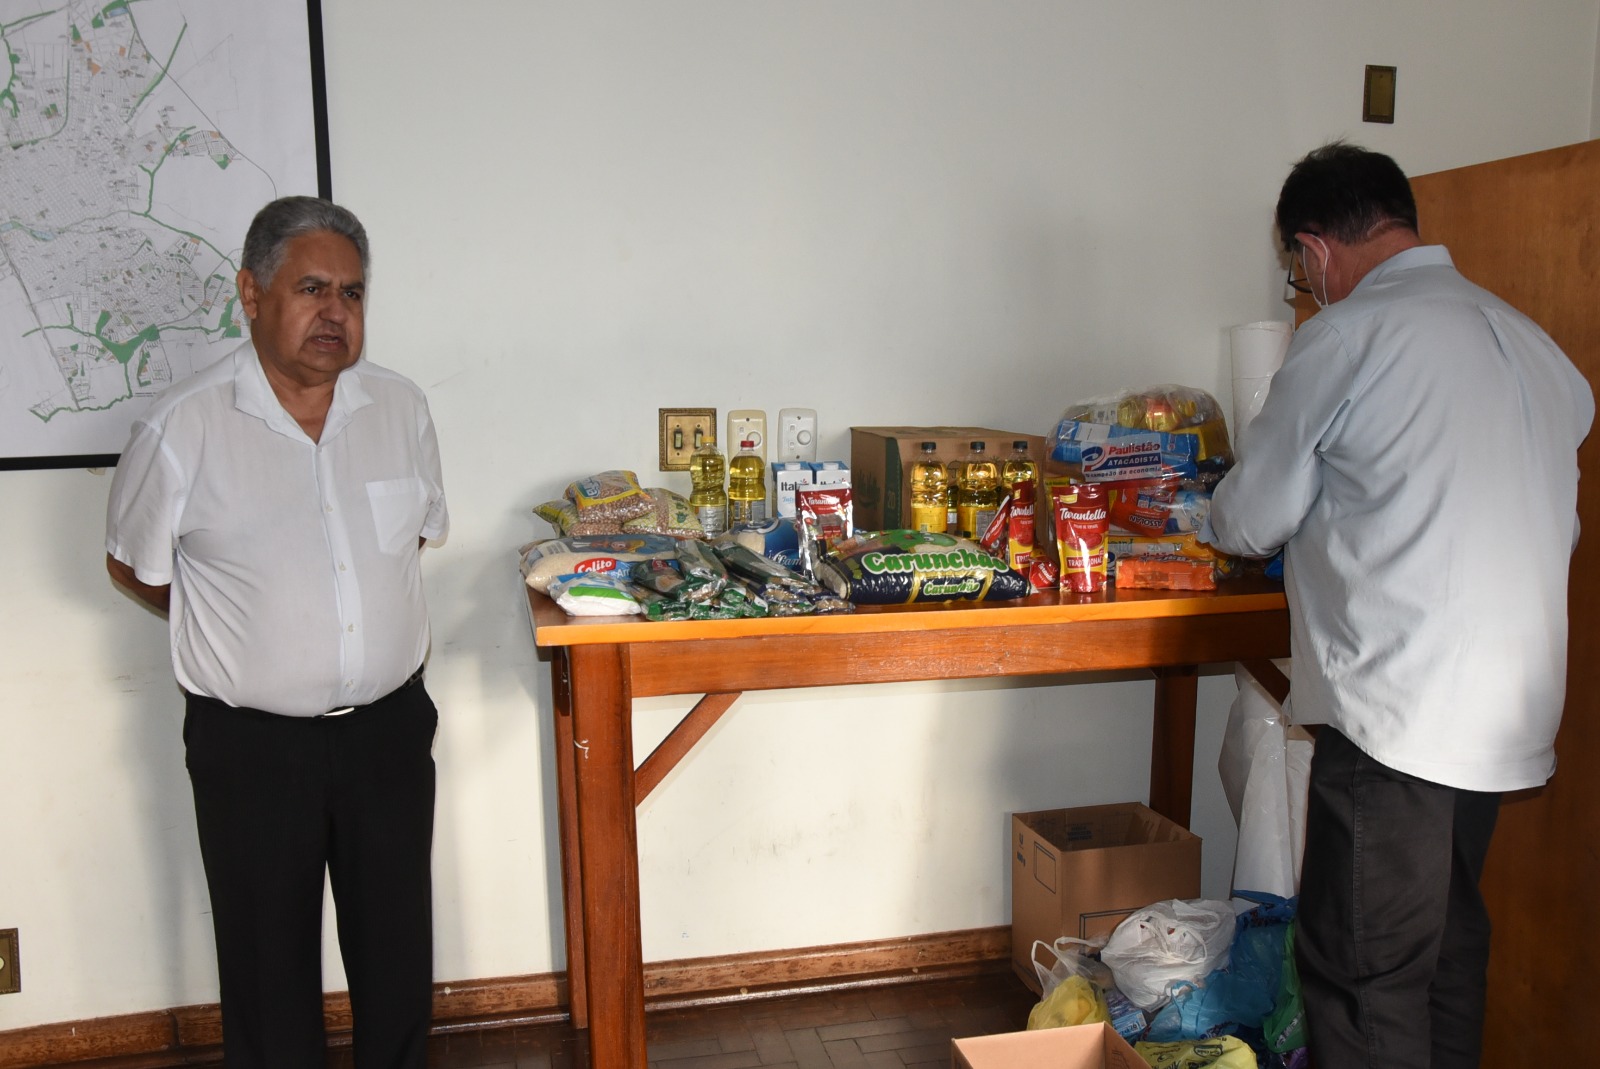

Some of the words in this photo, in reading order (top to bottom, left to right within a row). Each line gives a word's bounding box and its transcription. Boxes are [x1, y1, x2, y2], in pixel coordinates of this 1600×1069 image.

[1108, 441, 1161, 455] Paulistão
[1107, 456, 1159, 466] ATACADISTA
[781, 481, 806, 492] Ital
[1060, 507, 1106, 520] Tarantella
[1129, 515, 1164, 528] ASSOLAN
[862, 549, 1010, 574] Carunchão
